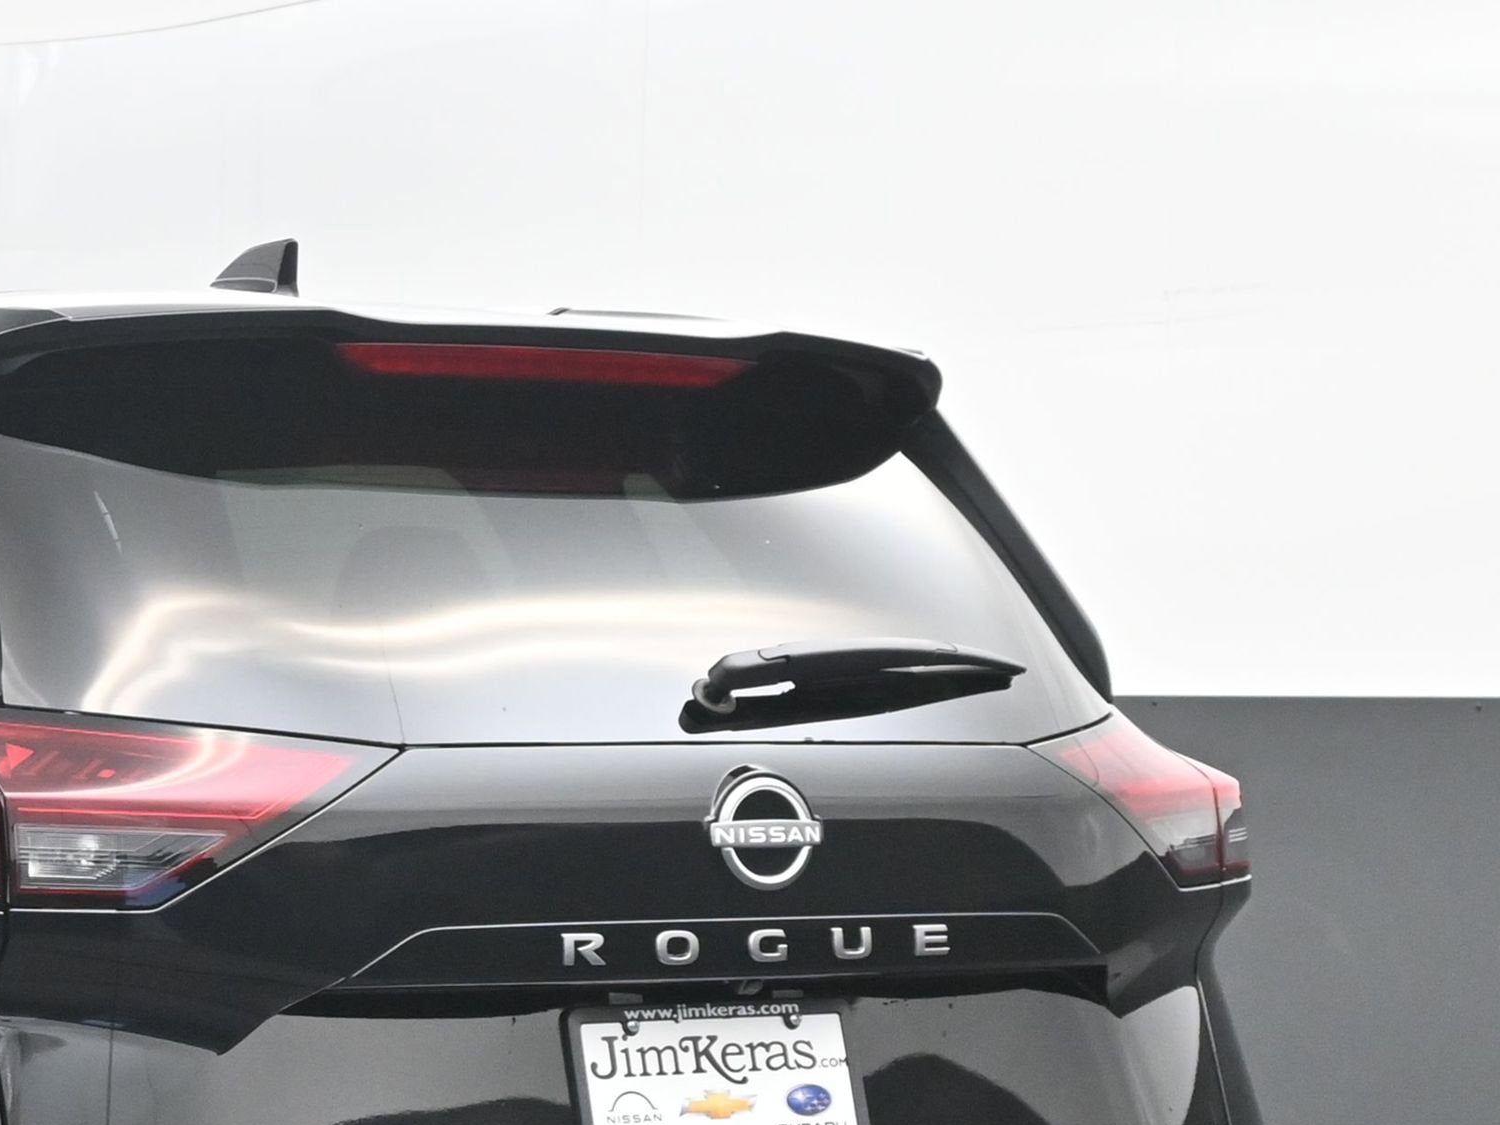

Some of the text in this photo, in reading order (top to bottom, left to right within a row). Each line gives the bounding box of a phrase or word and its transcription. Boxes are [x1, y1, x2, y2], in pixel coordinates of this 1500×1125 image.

[714, 825, 822, 845] NISSAN
[560, 923, 952, 966] ROGUE
[624, 1001, 800, 1021] www.jimkeras.com
[606, 1112, 662, 1124] NISSAN
